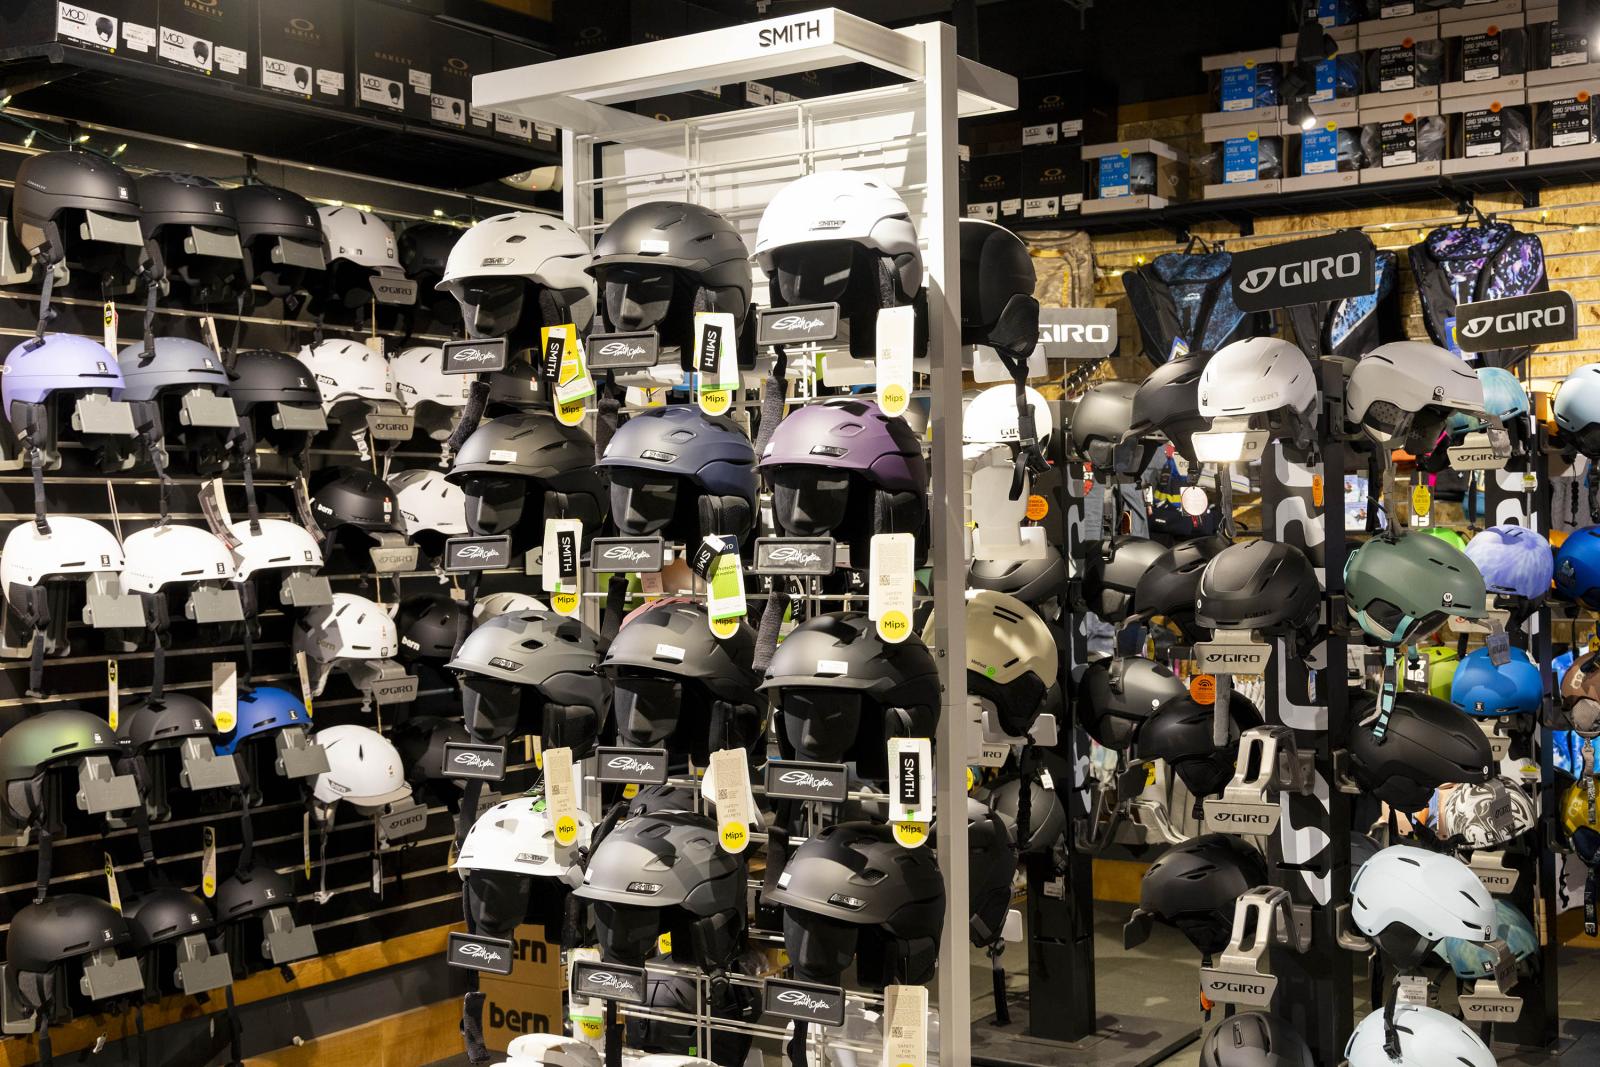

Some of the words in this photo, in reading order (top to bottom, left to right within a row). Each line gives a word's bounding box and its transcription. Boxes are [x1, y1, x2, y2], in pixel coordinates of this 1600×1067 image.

[759, 20, 820, 48] SMITH
[340, 246, 362, 256] bn
[1280, 252, 1360, 287] GIRO
[388, 287, 412, 296] GIRO
[1496, 306, 1565, 333] GIRO
[705, 330, 717, 367] SMITH
[546, 342, 560, 377] SMITH
[705, 394, 724, 404] Mips
[884, 394, 904, 403] Mips
[562, 405, 580, 414] Mips
[562, 536, 572, 572] SMITH
[696, 550, 710, 576] SMI
[557, 595, 575, 604] Mips
[884, 620, 905, 630] Mips
[401, 636, 420, 650] bern
[1223, 654, 1260, 662] GIRO
[388, 682, 413, 694] GIRO
[904, 758, 914, 798] SMITH
[399, 814, 422, 826] GIRO
[1232, 814, 1270, 824] GIRO
[559, 824, 574, 833] Mips
[901, 825, 922, 834] Mips
[726, 831, 743, 840] Mips
[1479, 877, 1509, 885] GIRO
[1227, 983, 1265, 994] GIRO
[1482, 1005, 1514, 1013] GIRO
[490, 1002, 549, 1034] bern
